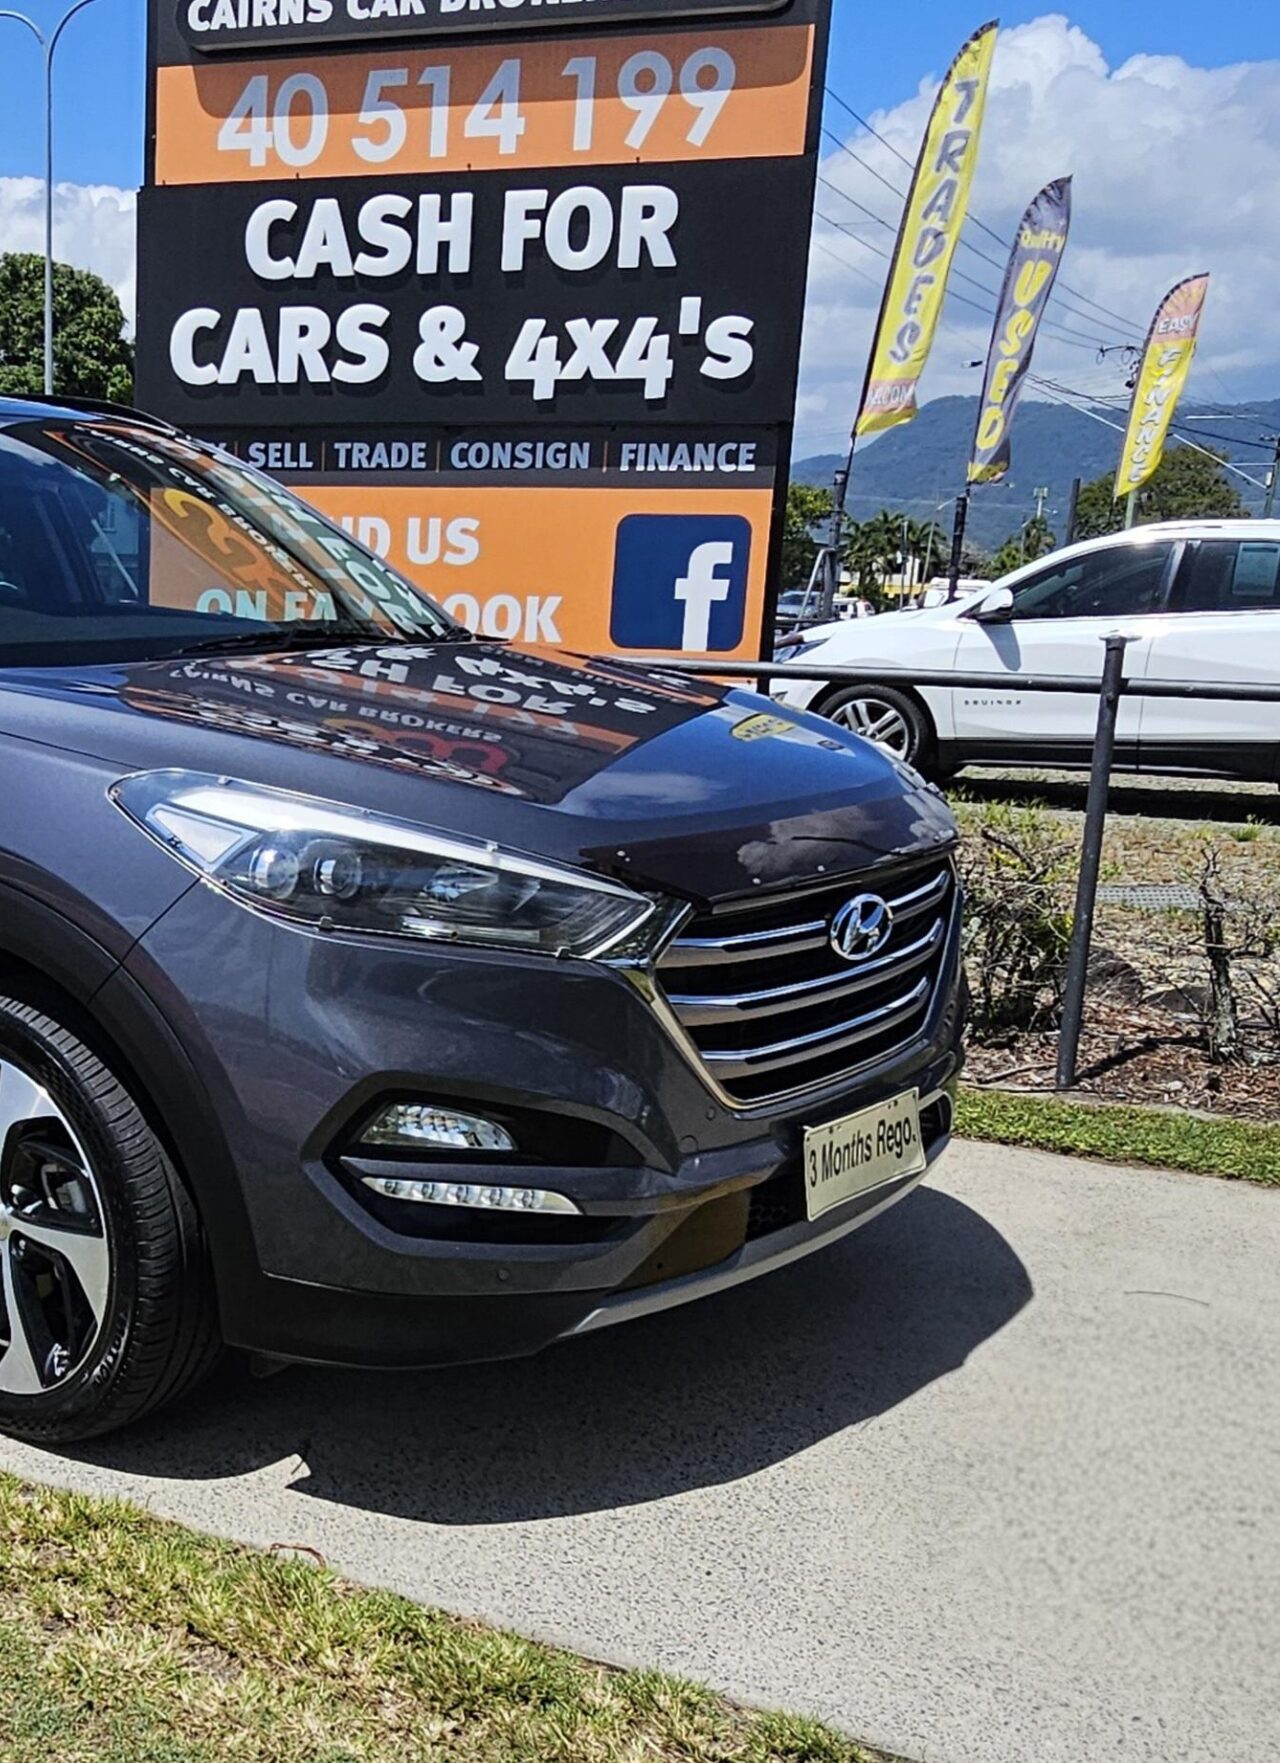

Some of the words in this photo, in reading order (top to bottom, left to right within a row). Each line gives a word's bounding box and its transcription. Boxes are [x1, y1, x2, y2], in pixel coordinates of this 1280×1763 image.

[187, 0, 333, 31] CAIRNS
[217, 73, 328, 167] 40
[351, 58, 525, 159] 514
[562, 47, 736, 151] 199
[245, 192, 473, 280] CASH
[501, 186, 678, 272] FOR
[889, 79, 979, 362] TRADES
[169, 304, 391, 385] CARS
[413, 305, 482, 382] &
[976, 259, 1053, 450] USED
[248, 442, 314, 468] SELL
[333, 442, 427, 469] TRADE
[450, 441, 591, 470] CONSIGN
[619, 442, 756, 472] FINANCE
[406, 516, 480, 566] US
[810, 1149, 817, 1188] 3
[822, 1130, 872, 1182] Months
